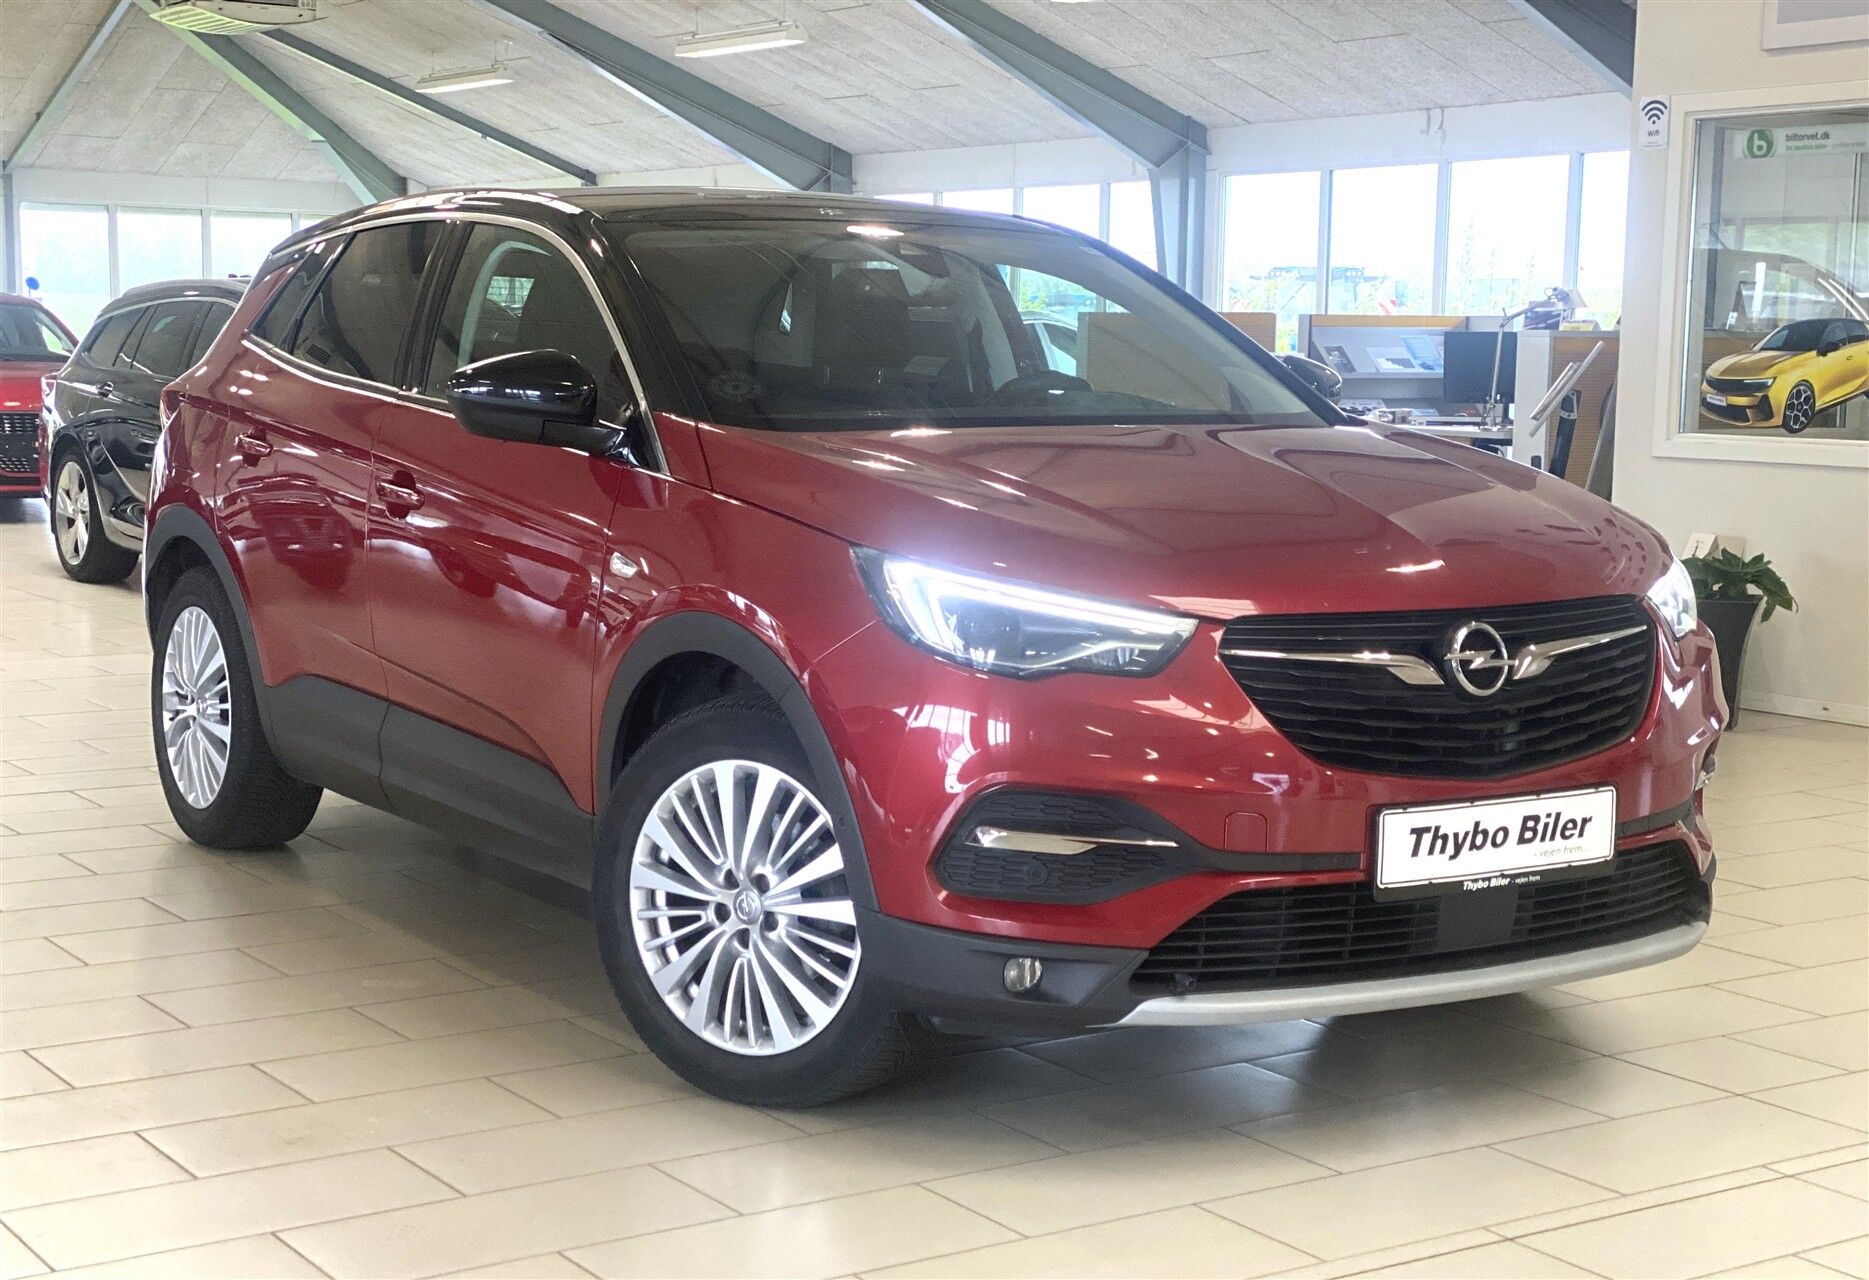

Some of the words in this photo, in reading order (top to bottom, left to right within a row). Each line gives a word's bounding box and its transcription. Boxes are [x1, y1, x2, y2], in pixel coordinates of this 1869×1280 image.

[1409, 821, 1510, 861] Thybo
[1517, 811, 1593, 846] Biler
[1463, 879, 1489, 891] Thybo
[1490, 877, 1511, 888] Biler
